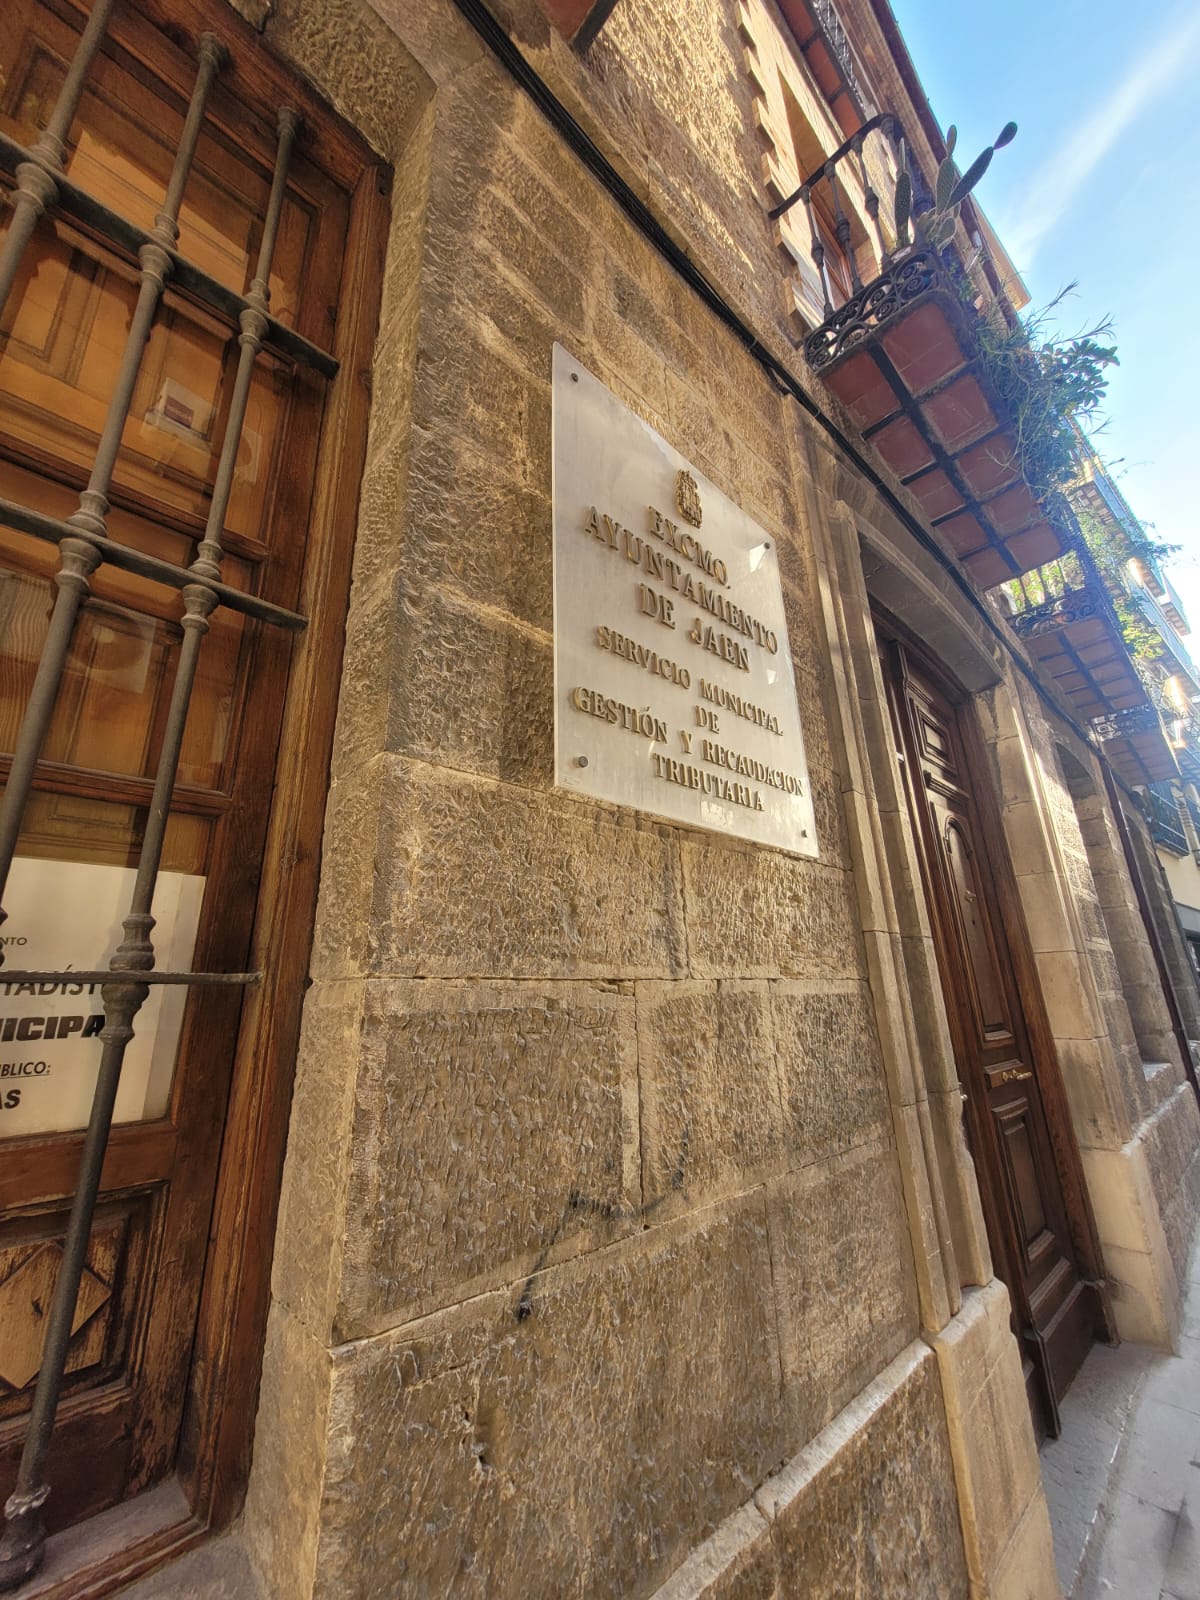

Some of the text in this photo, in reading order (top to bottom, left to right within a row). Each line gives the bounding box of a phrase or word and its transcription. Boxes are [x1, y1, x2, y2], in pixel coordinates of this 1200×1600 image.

[584, 505, 778, 655] AYUNTAMIENTO
[648, 505, 731, 590] EXCMO.
[639, 582, 751, 673] DE JAEN
[598, 626, 784, 736] SERVICIO MUNICIPAL
[695, 705, 720, 734] DE
[573, 686, 804, 797] GESTIÓN Y RECAUDACION
[653, 752, 765, 811] TRIBUTARIA
[0, 1014, 106, 1042] ICIPA
[0, 1061, 51, 1077] BLICO:
